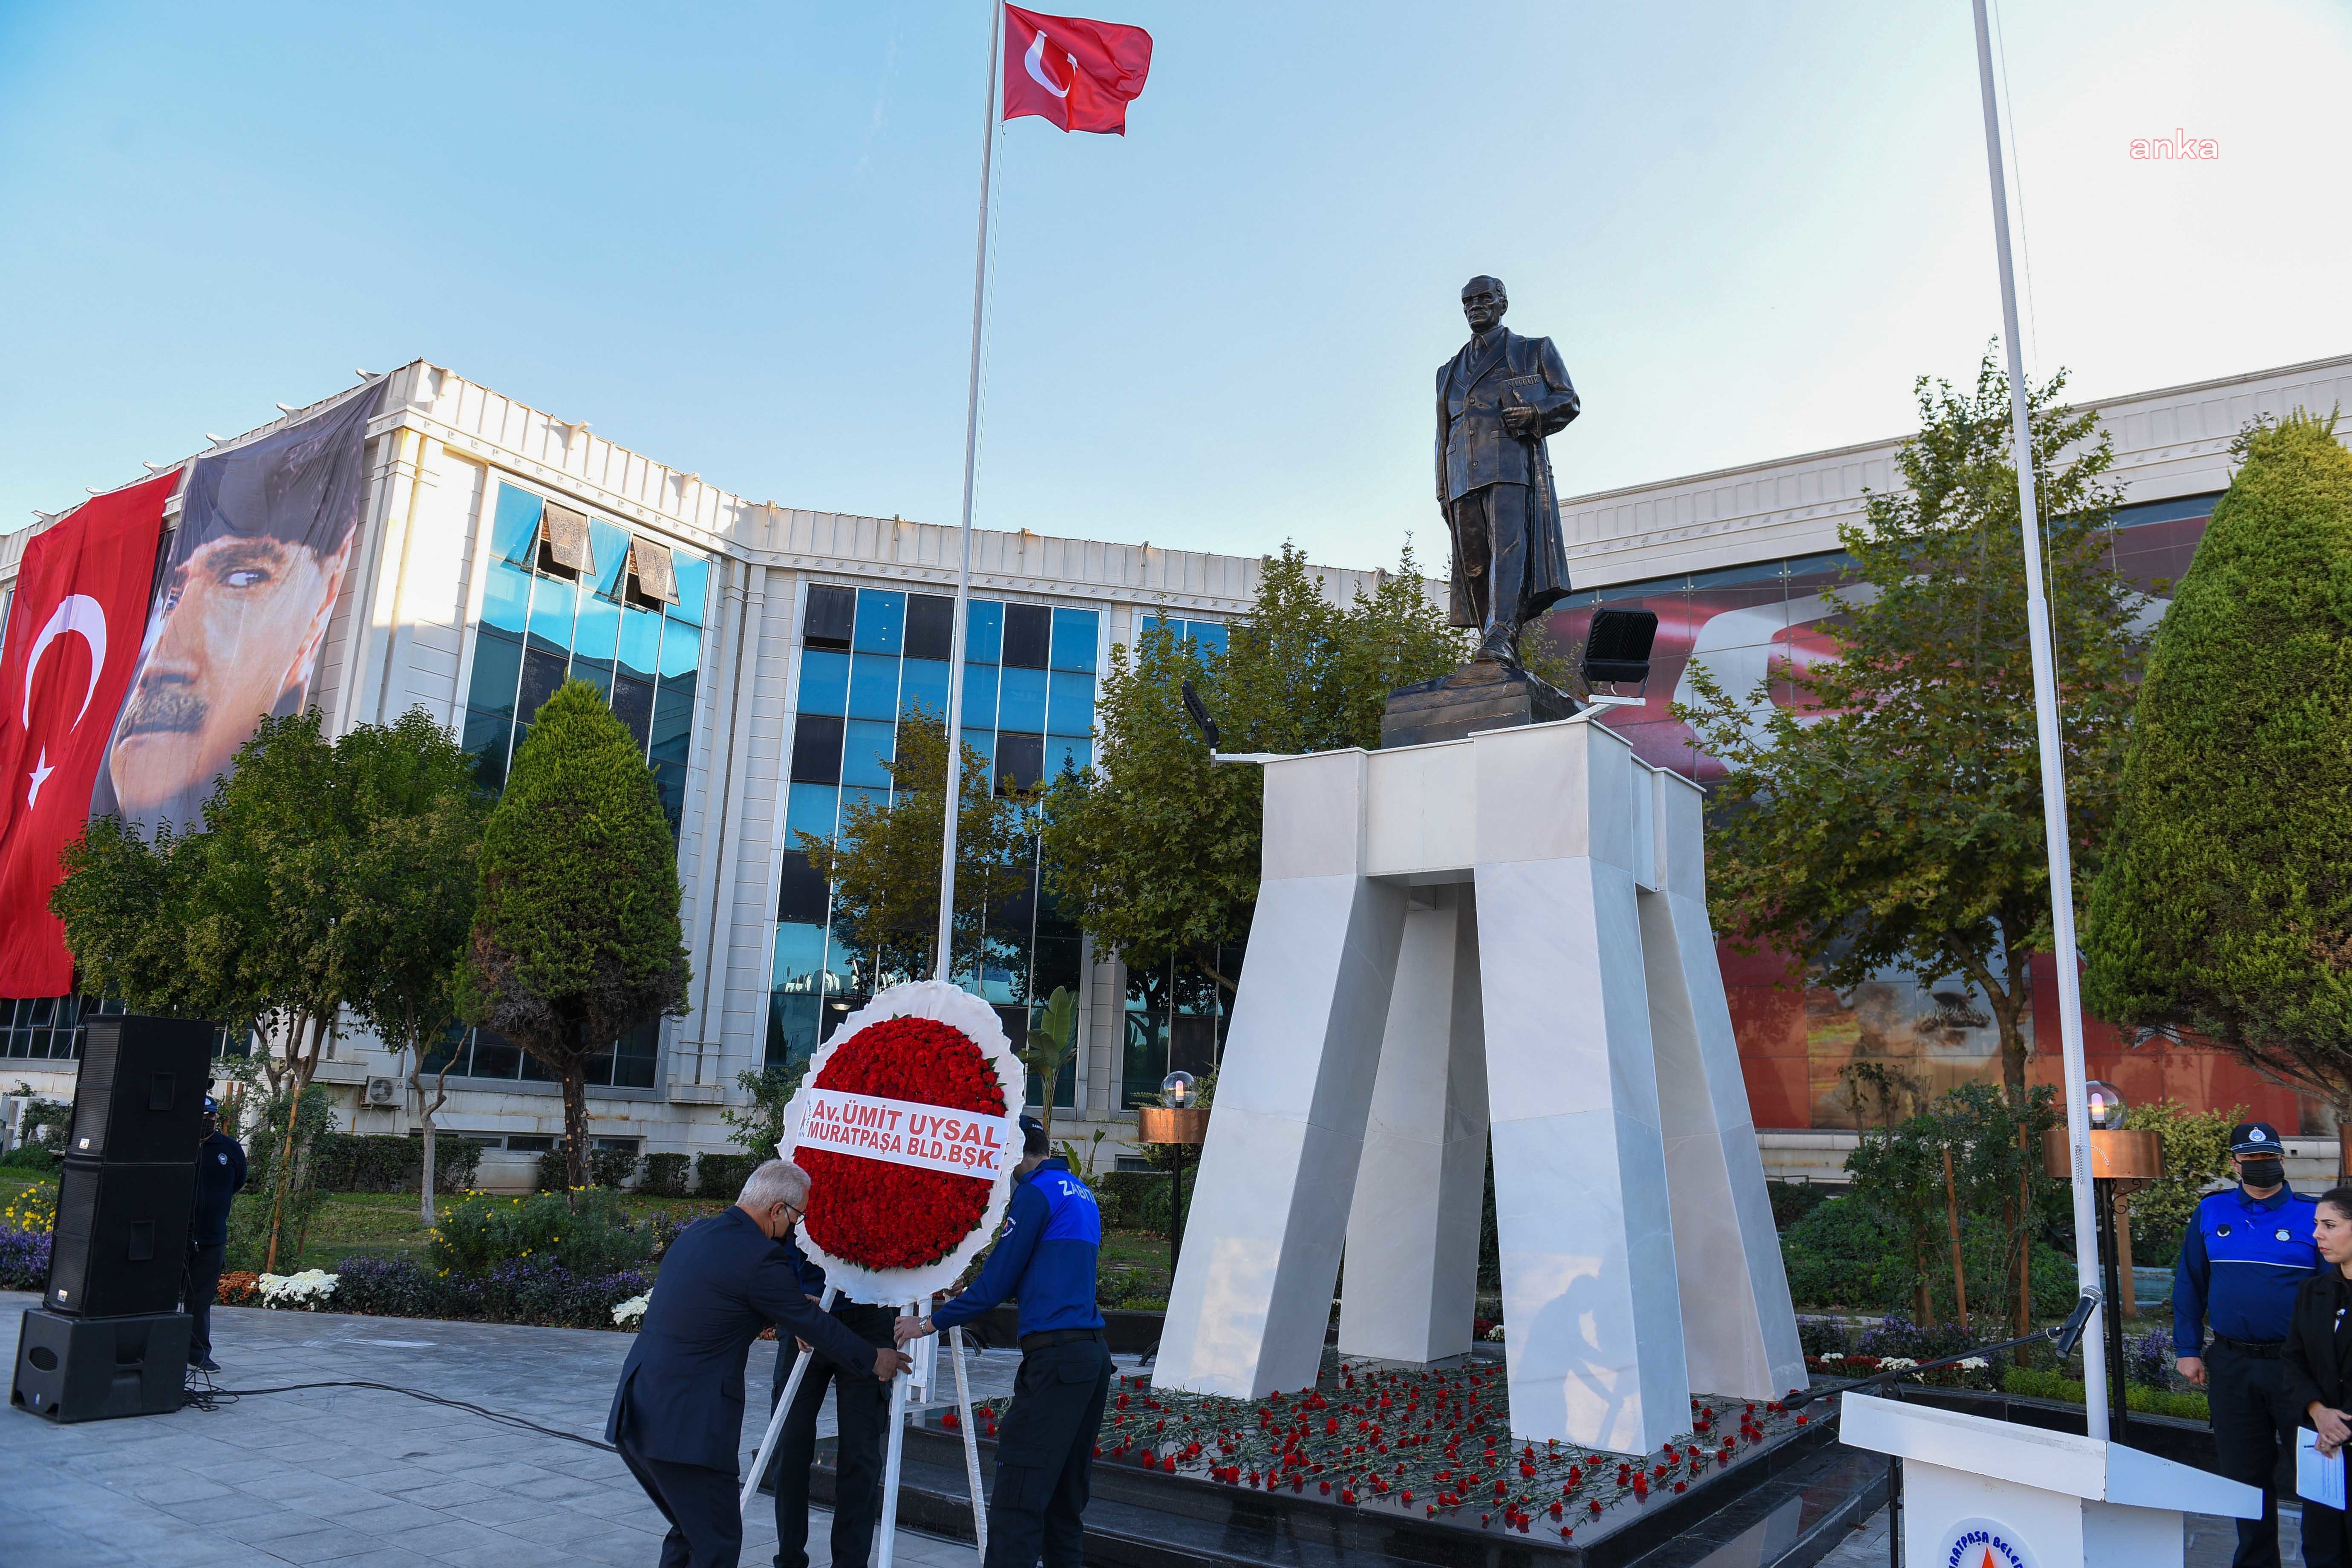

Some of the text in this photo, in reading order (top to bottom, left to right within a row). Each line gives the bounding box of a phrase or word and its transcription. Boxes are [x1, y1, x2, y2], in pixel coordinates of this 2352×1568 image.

[1506, 377, 1540, 388] NUTUK
[807, 1121, 999, 1170] MURATPAŞA BLD.BŞK.
[909, 1113, 1001, 1149] UYSAL
